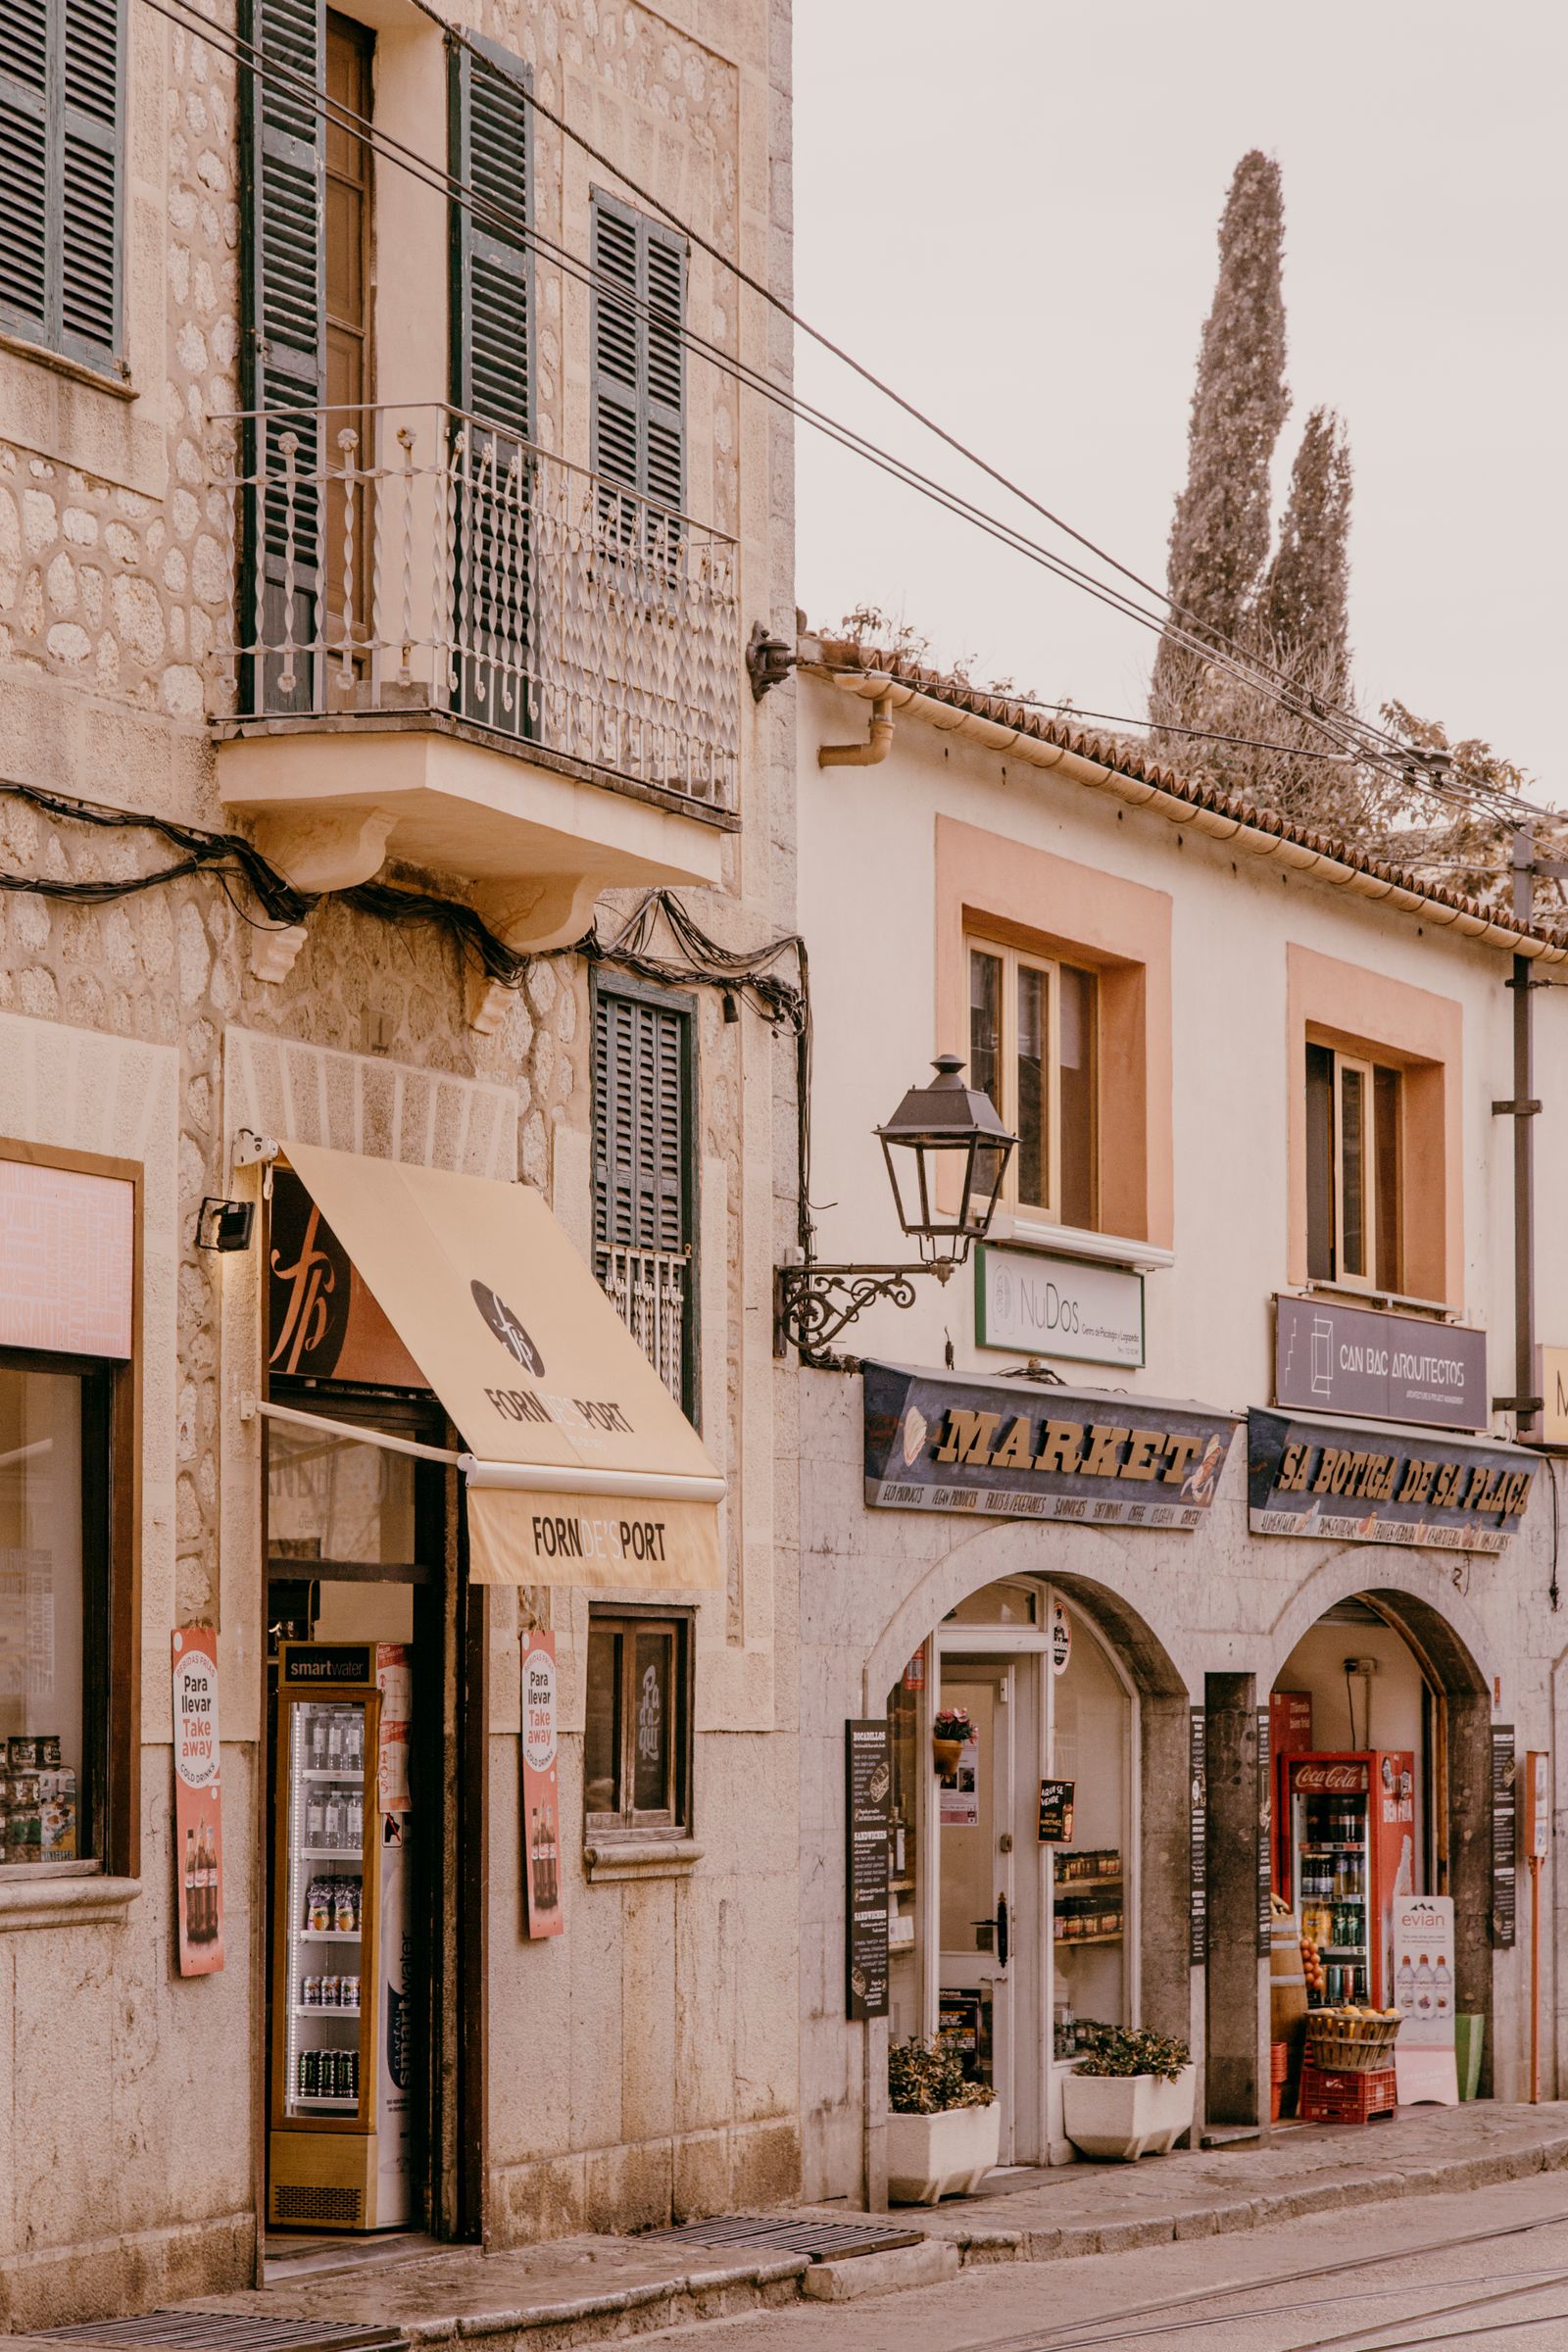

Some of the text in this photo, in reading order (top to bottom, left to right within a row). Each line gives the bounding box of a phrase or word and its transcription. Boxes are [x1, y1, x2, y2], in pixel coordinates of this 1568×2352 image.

[1340, 1344, 1464, 1387] CAN BAC ARQUITECTOS
[483, 1388, 553, 1423] FORN
[572, 1398, 635, 1433] PORT
[935, 1408, 1203, 1485] MARKET
[1277, 1443, 1314, 1491] SA
[1313, 1447, 1398, 1499] BOTIGA
[1397, 1458, 1432, 1502] DE
[1432, 1461, 1462, 1506] SA
[532, 1516, 583, 1557] FORN
[619, 1521, 665, 1561] PORT
[290, 1660, 365, 1676] smartwater
[184, 1675, 208, 1692] Para
[530, 1671, 549, 1687] Para
[181, 1695, 212, 1713] llevar
[528, 1689, 551, 1705] llevar
[528, 1709, 551, 1726] Take
[182, 1717, 212, 1738] Take
[527, 1729, 552, 1746] away
[182, 1740, 213, 1759] away
[180, 1762, 216, 1784] COLD DRINKS
[1295, 1765, 1361, 1788] Coca-Cola
[1401, 1912, 1445, 1927] evian
